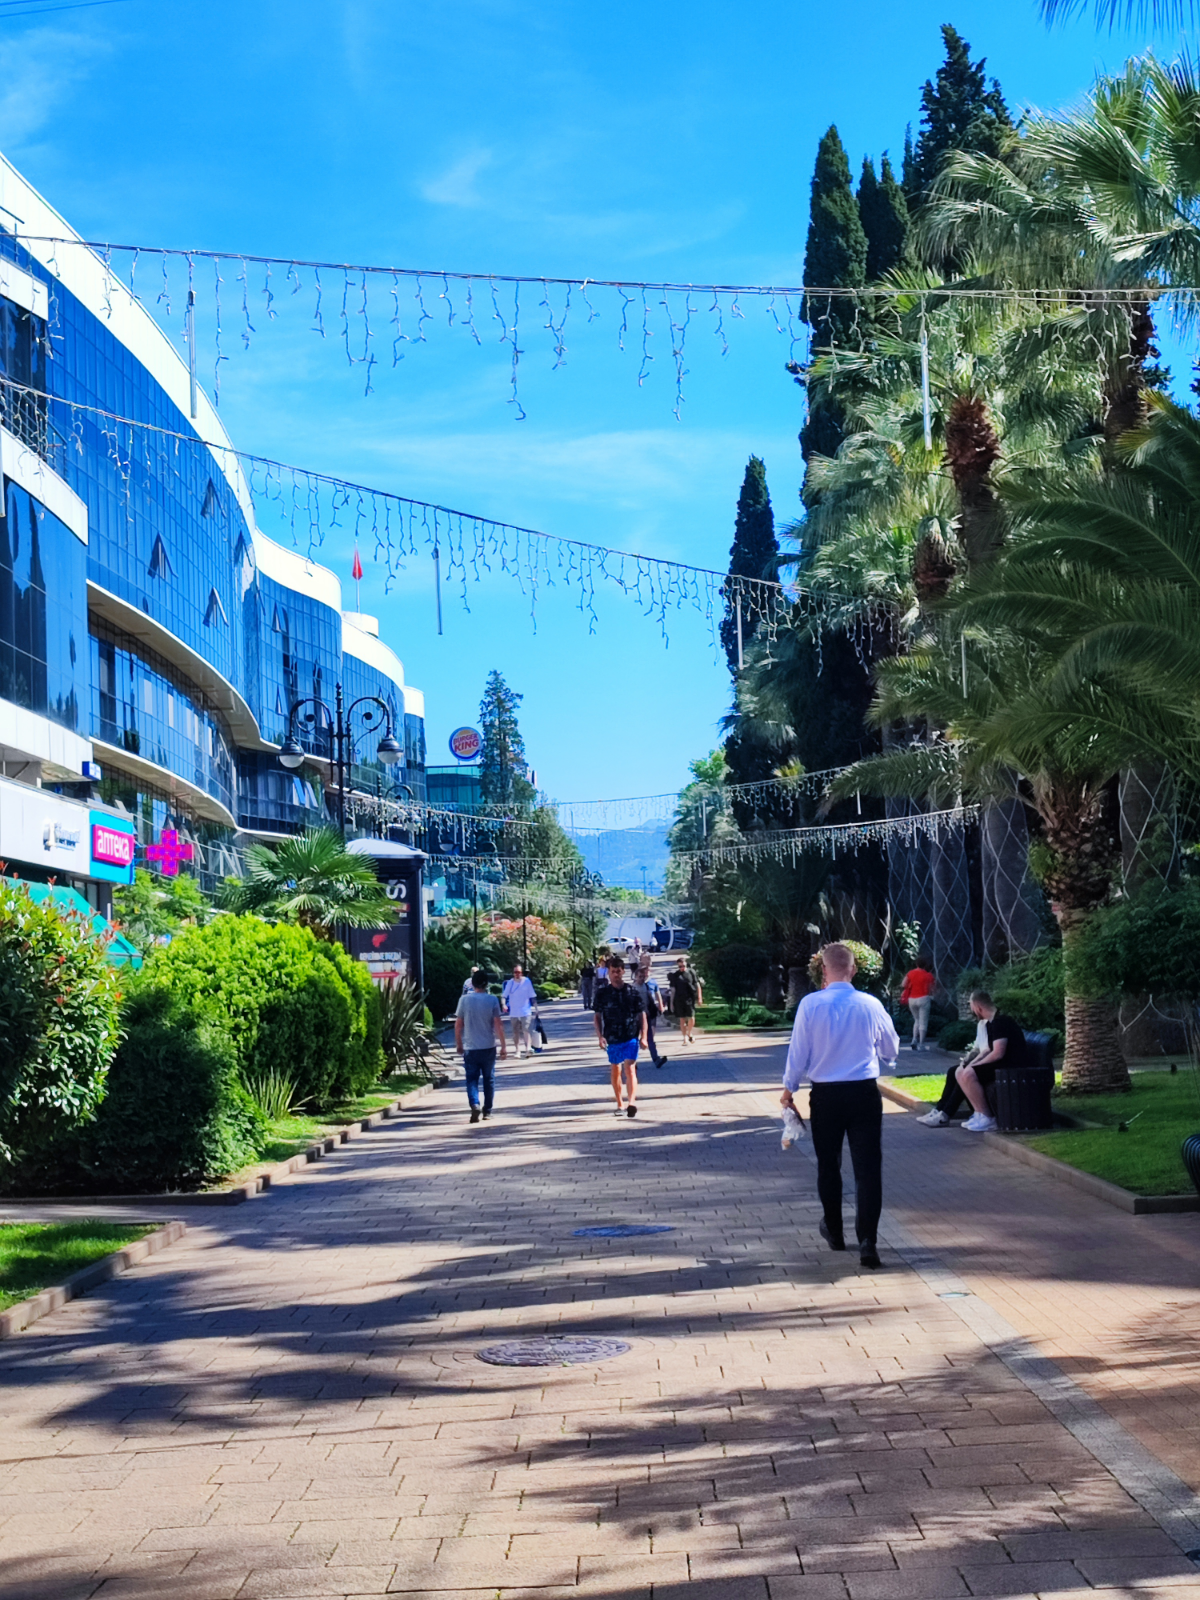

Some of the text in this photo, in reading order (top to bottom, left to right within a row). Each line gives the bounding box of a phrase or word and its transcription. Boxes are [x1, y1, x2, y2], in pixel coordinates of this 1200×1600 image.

[453, 733, 478, 745] BURGER
[454, 739, 479, 752] KING
[97, 830, 130, 861] аптека
